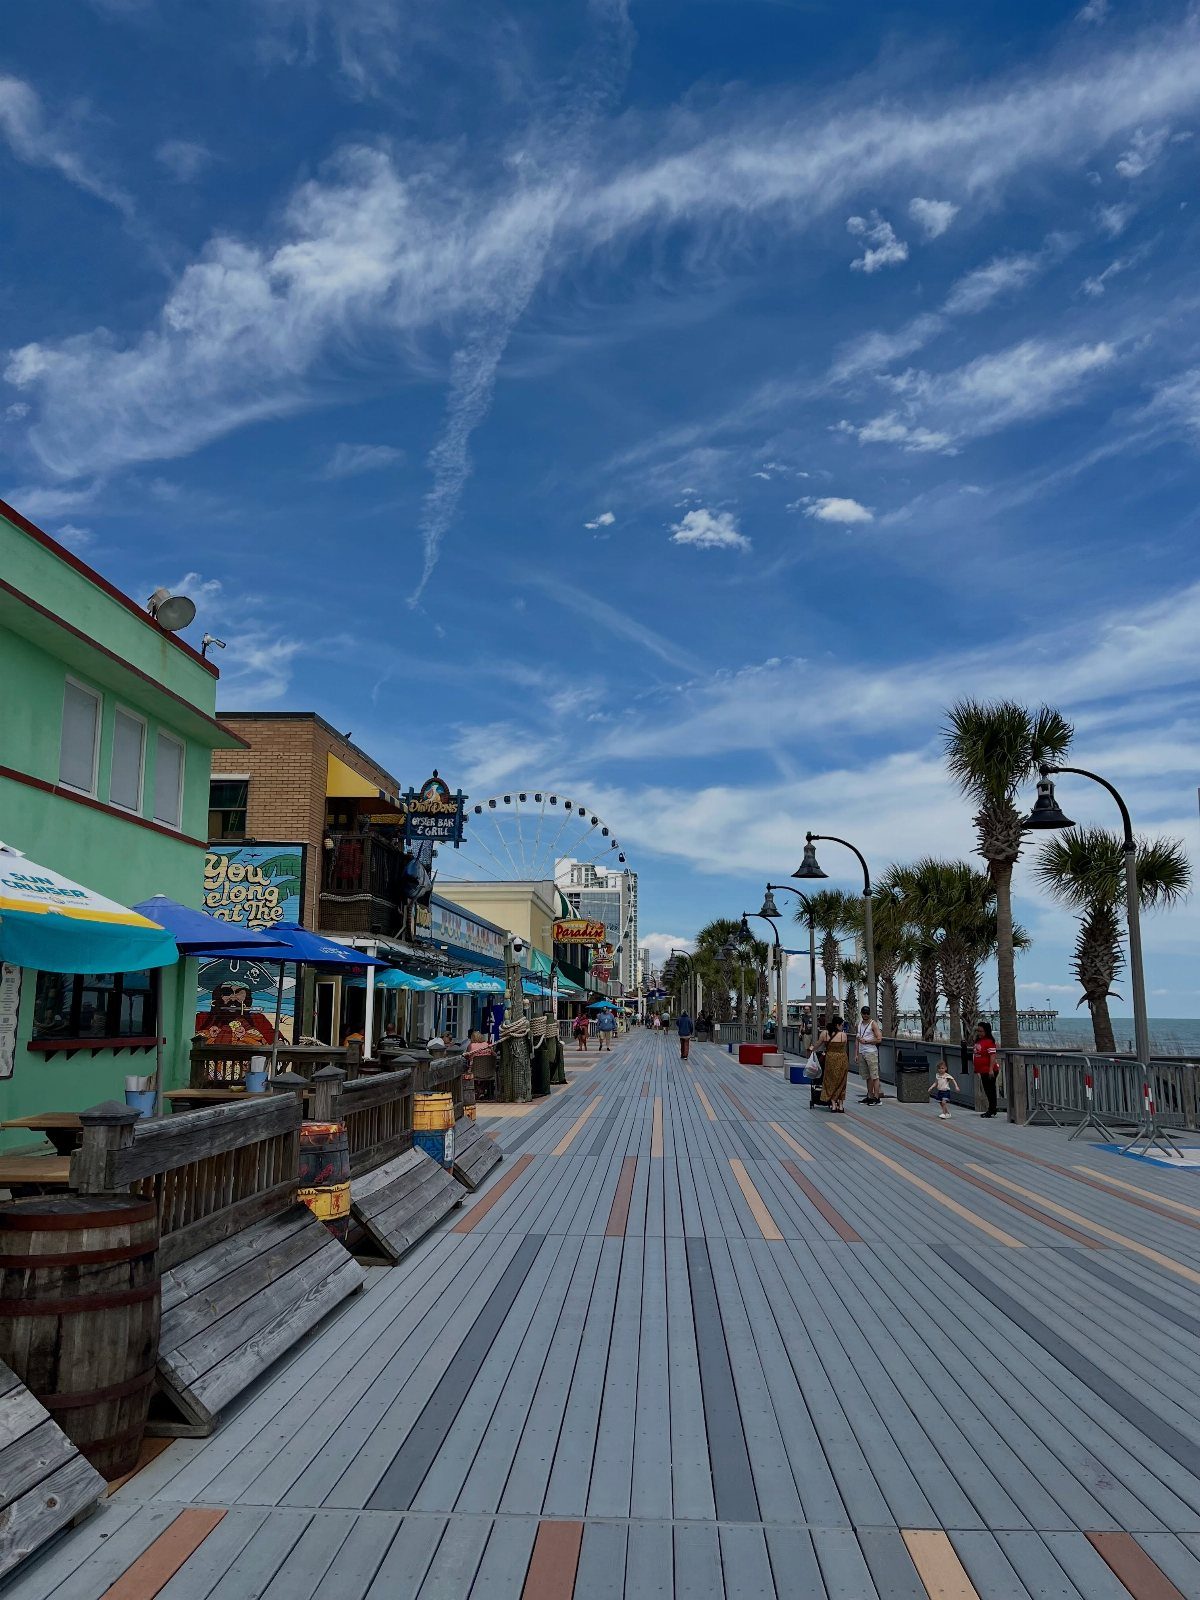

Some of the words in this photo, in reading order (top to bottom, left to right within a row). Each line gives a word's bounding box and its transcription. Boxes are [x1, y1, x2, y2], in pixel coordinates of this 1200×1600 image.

[411, 817, 436, 827] OYSTER
[437, 818, 454, 828] BAR
[417, 826, 424, 835] &
[425, 827, 449, 836] GRILL
[9, 872, 55, 886] SUN
[204, 854, 271, 890] You
[1, 879, 89, 899] CRUISER
[203, 881, 280, 908] elong
[243, 900, 285, 922] The
